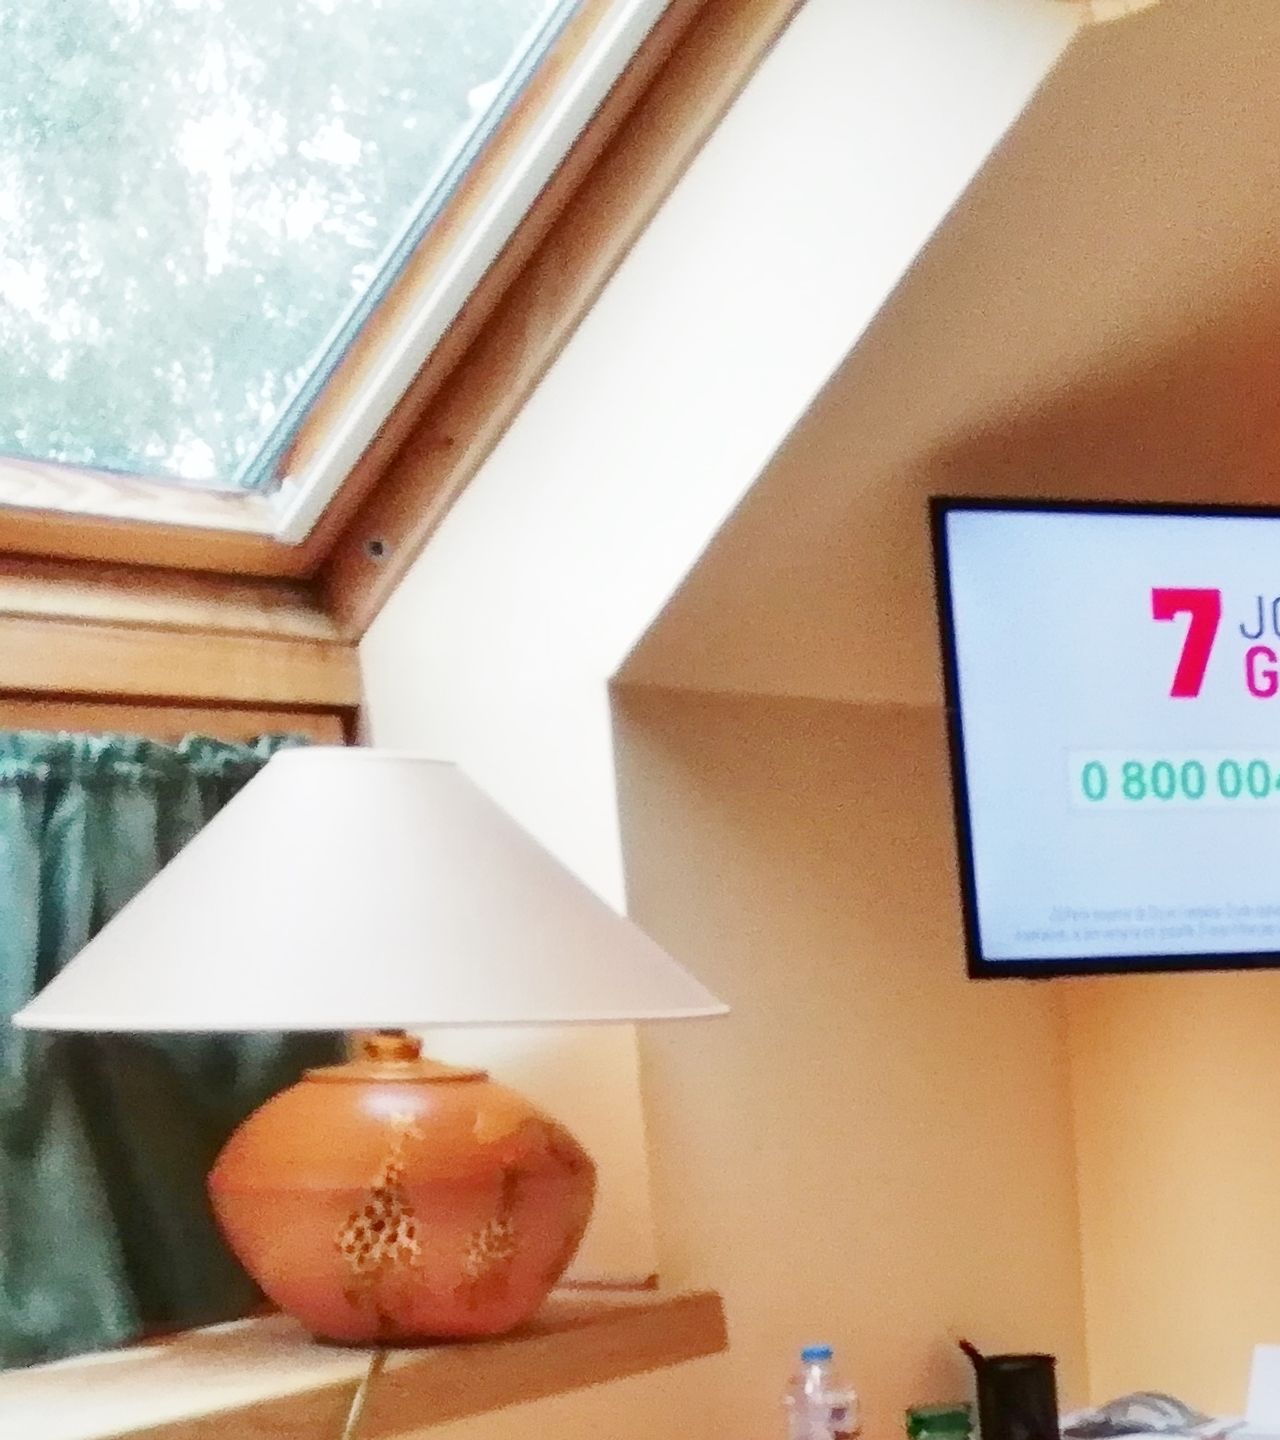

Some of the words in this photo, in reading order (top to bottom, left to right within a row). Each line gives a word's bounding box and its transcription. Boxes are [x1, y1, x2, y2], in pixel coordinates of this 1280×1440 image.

[1152, 588, 1221, 698] 7
[1082, 760, 1107, 801] 0
[1122, 760, 1206, 800] 800
